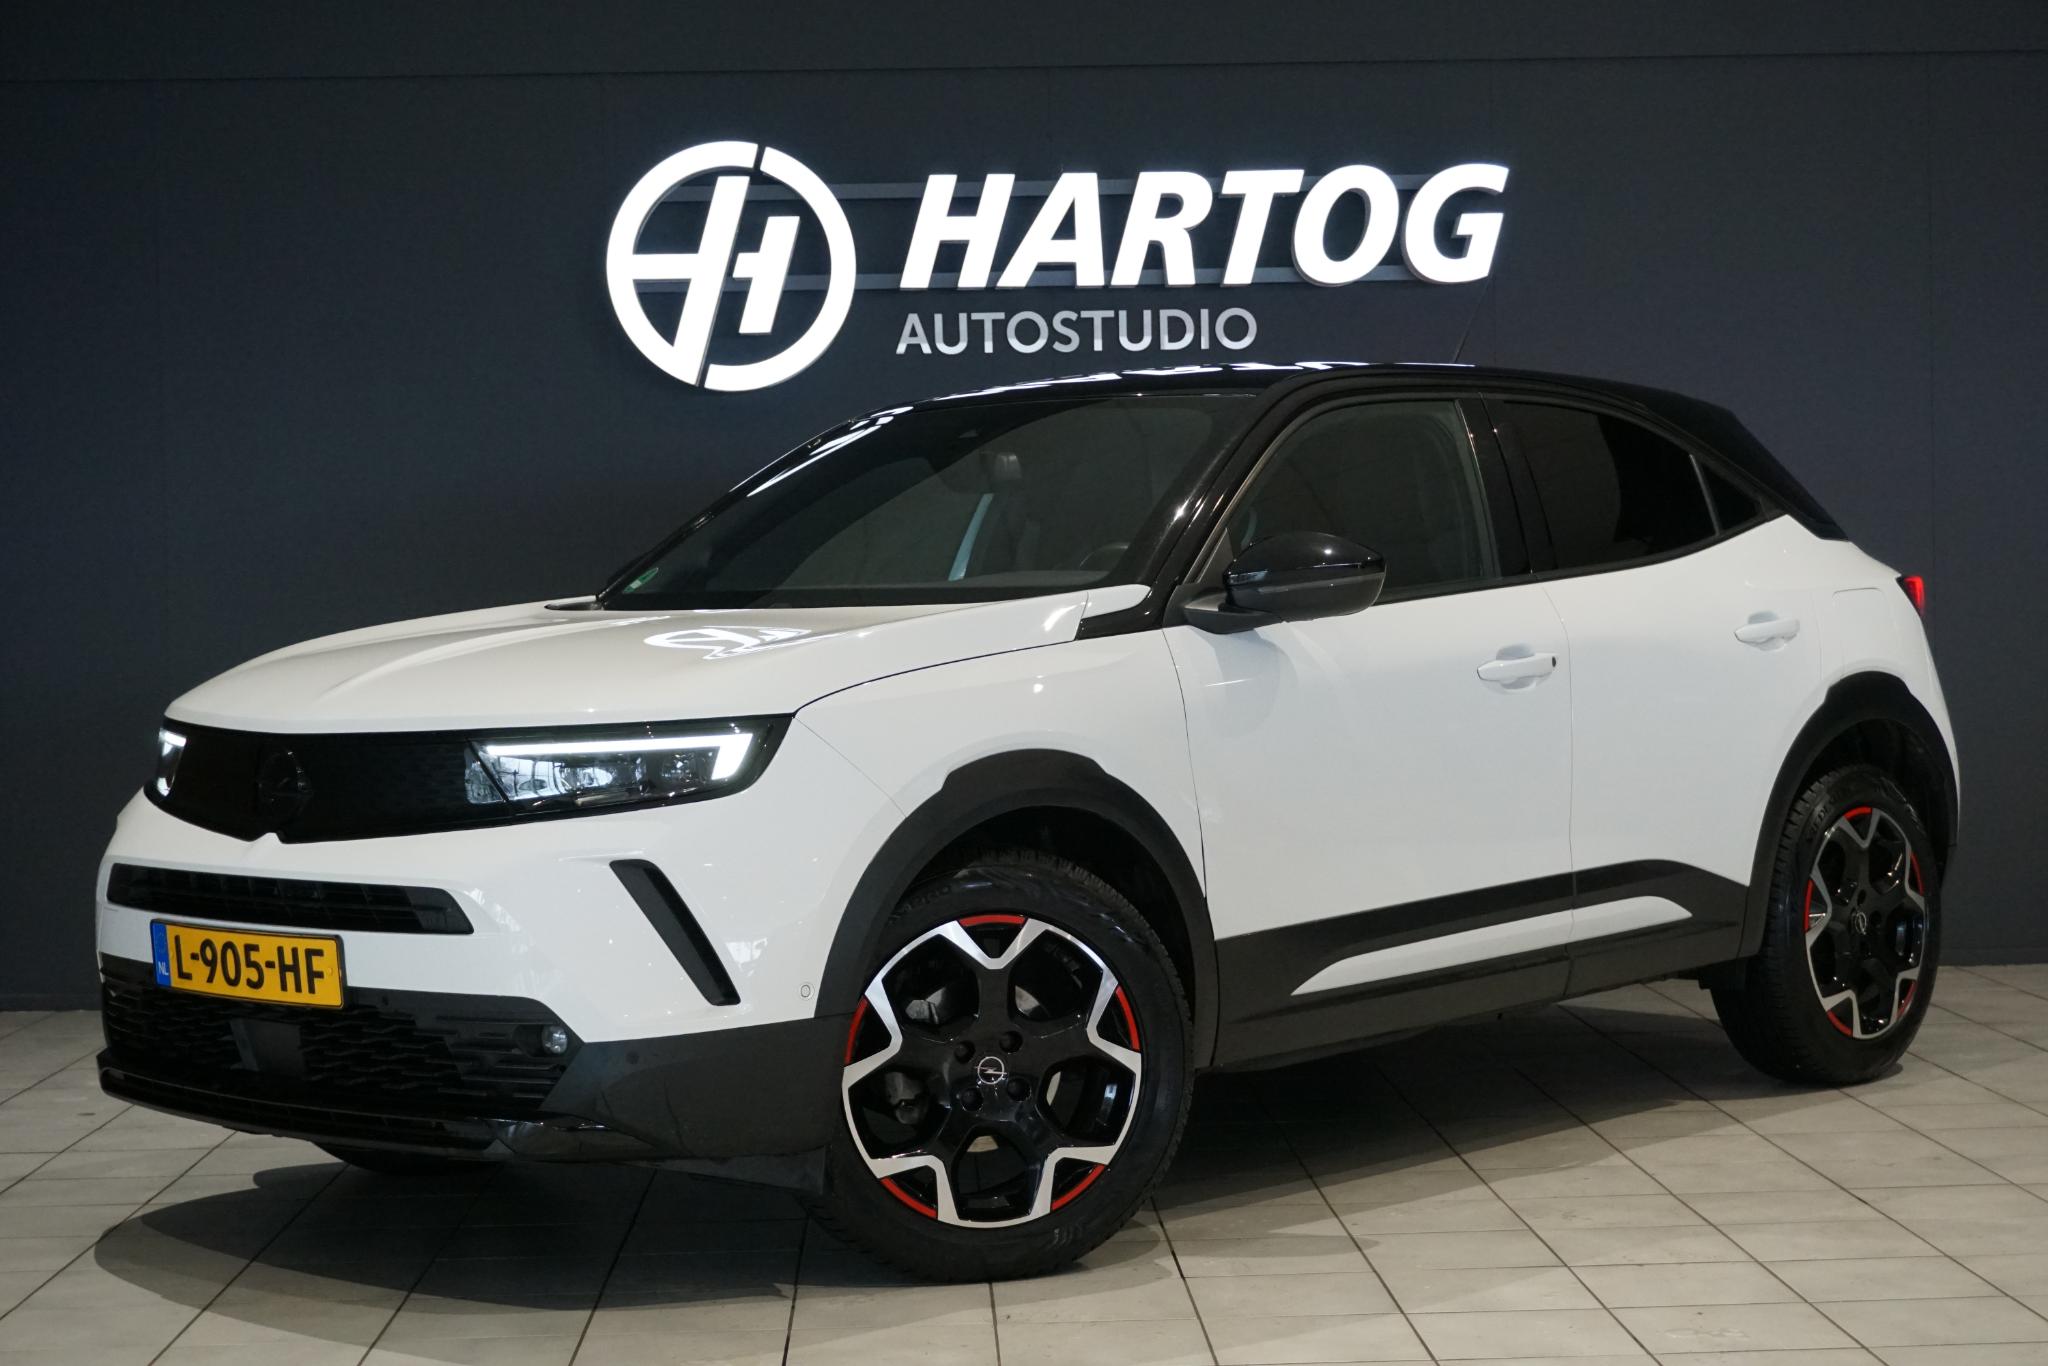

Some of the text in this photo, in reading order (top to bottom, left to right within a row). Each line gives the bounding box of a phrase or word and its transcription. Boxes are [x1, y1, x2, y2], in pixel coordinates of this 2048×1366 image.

[899, 163, 1510, 288] HARTOG
[896, 307, 1258, 355] AUTOSTUDIO
[157, 961, 169, 976] NL
[174, 934, 325, 995] L-905-HF
